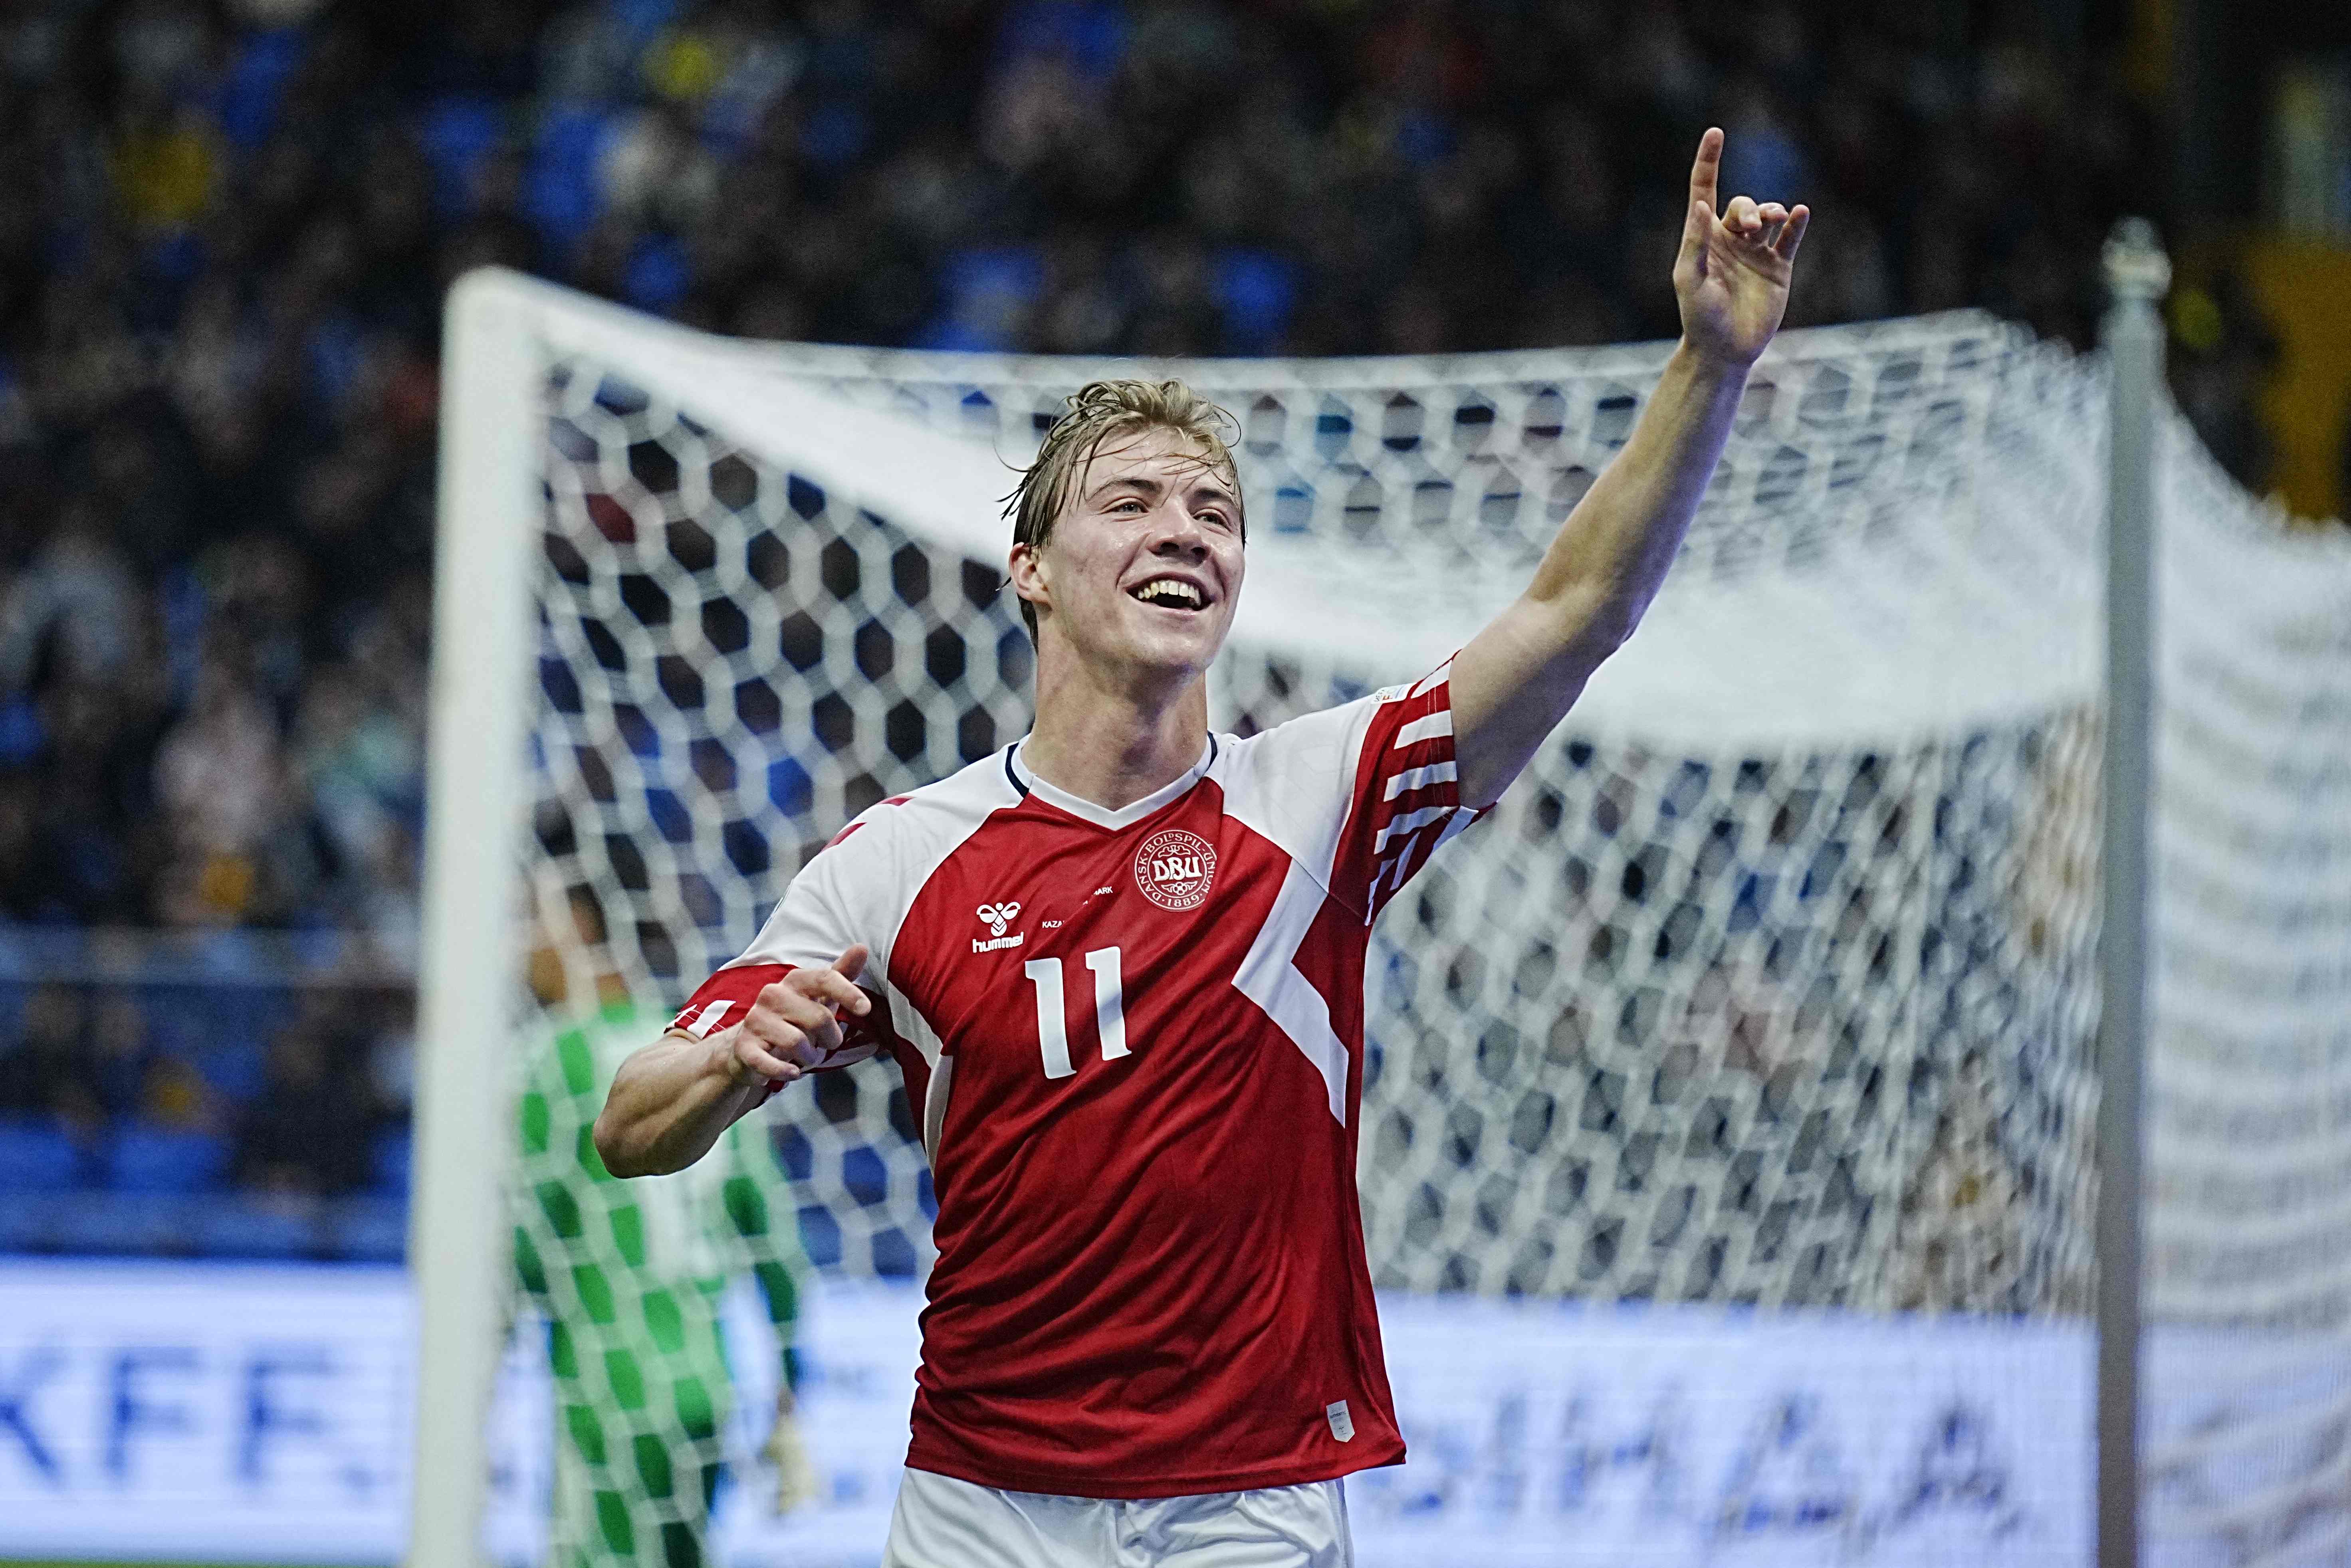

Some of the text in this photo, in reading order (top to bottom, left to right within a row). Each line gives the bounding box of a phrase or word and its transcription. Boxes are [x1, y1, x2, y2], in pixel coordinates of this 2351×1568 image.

[1138, 856, 1162, 901] DANSK
[1152, 857, 1202, 881] DBU
[1168, 895, 1199, 907] 1889
[972, 931, 1024, 953] hummel
[1025, 946, 1132, 1079] 11
